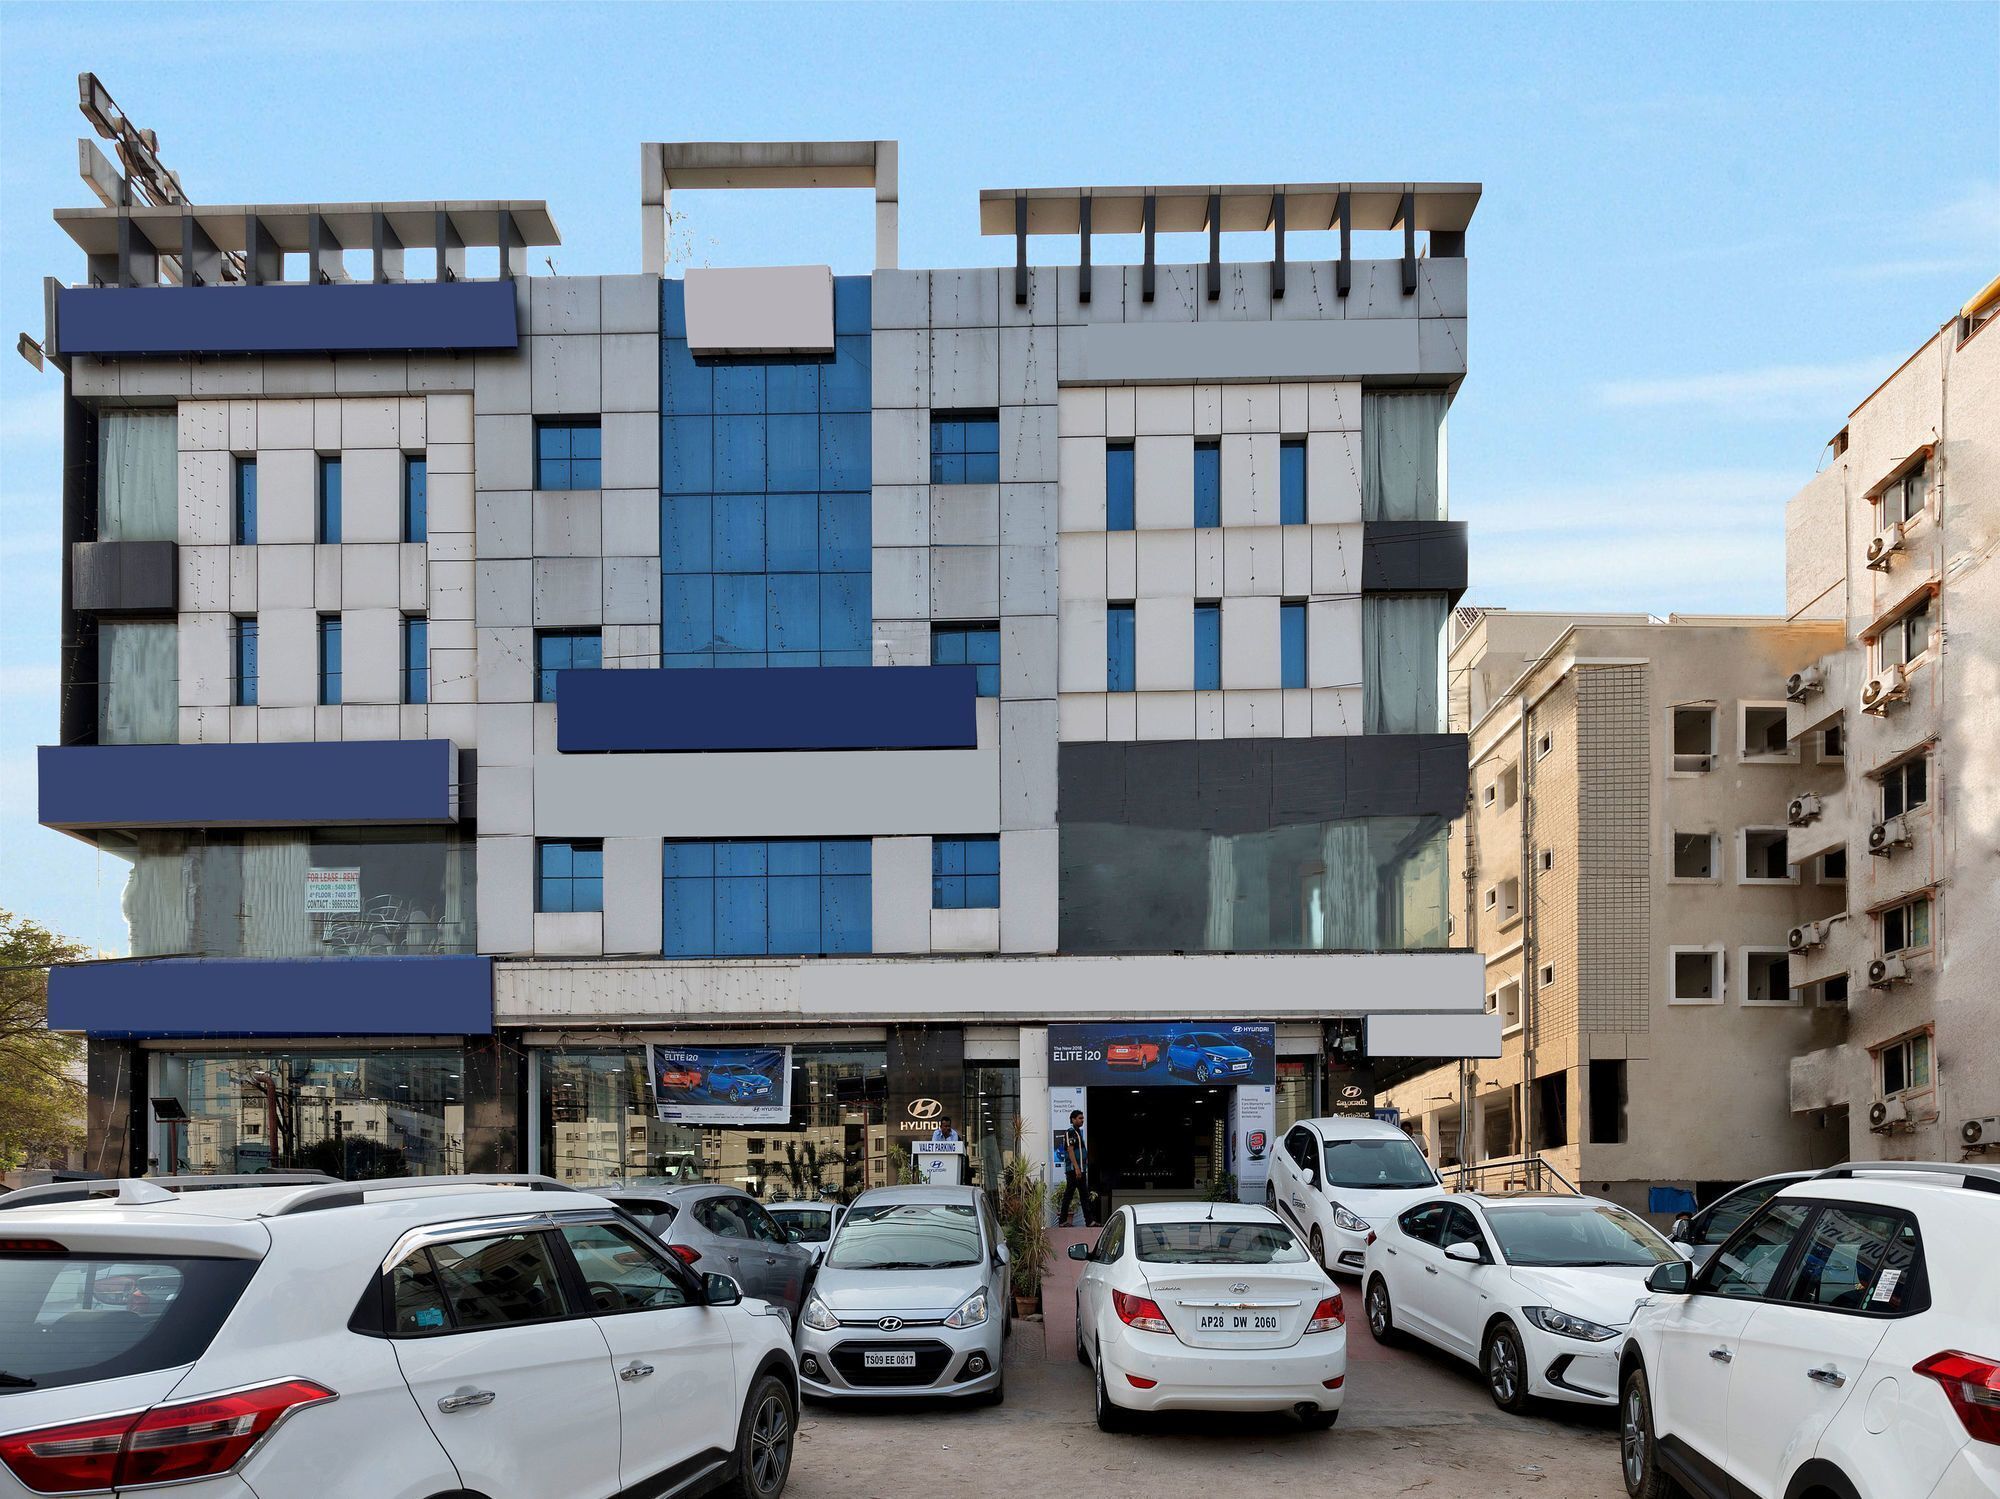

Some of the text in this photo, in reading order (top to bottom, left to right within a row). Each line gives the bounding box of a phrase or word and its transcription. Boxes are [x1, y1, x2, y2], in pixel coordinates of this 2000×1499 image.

[307, 873, 319, 882] FOR
[320, 873, 339, 882] LEASE
[343, 873, 359, 882] RENT
[307, 900, 328, 909] CONTACT
[664, 1053, 699, 1062] ELITE i20
[1053, 1050, 1101, 1061] ELITE i20
[901, 1121, 942, 1131] HYUND
[1250, 1133, 1264, 1147] 3
[919, 1143, 956, 1152] VALET PARKING
[1200, 1316, 1277, 1329] AP28 DW 2060
[865, 1355, 914, 1365] TS09 EE 0817
